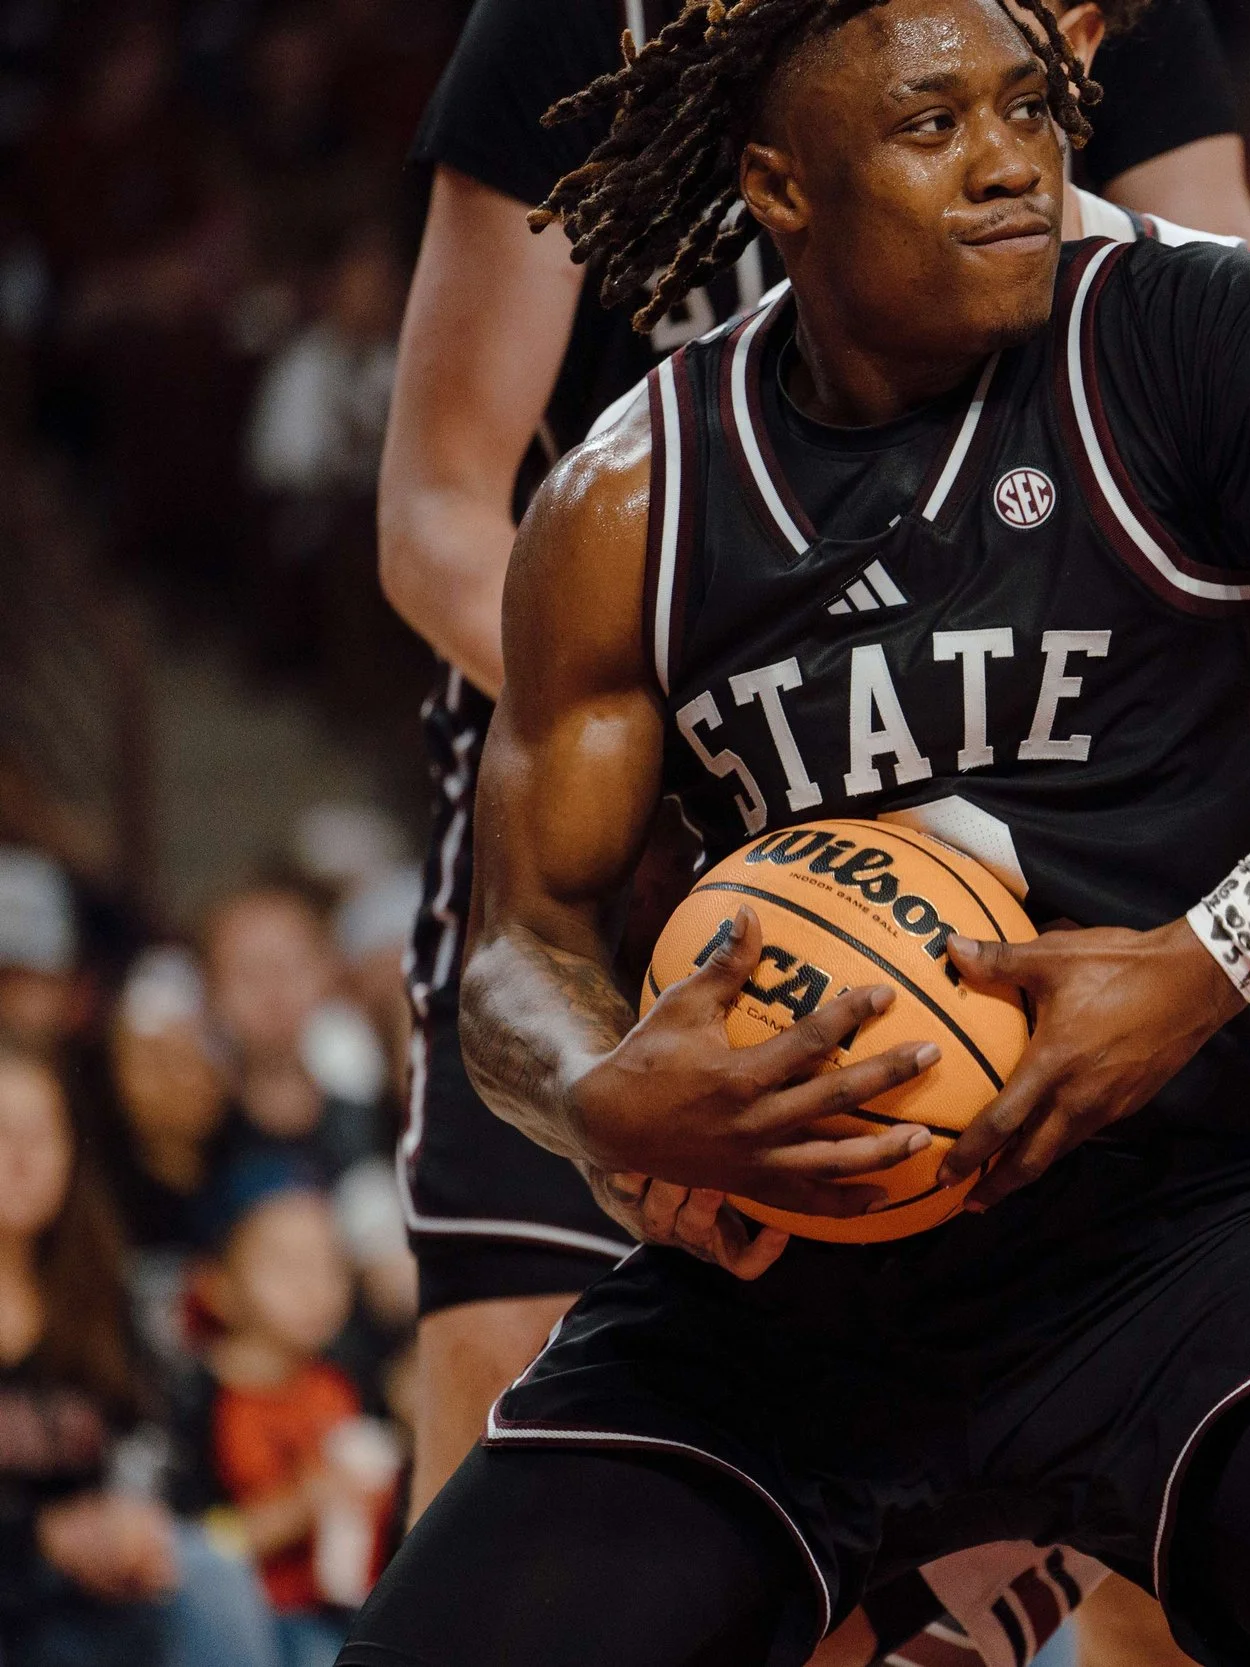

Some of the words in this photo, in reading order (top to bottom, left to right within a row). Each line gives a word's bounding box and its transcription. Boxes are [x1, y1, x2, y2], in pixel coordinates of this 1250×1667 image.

[998, 471, 1051, 525] SEC
[675, 627, 1112, 836] STATE
[789, 872, 834, 892] INDOOR
[836, 890, 870, 914] GAME
[872, 914, 899, 939] BALL
[693, 918, 862, 1052] CA
[746, 1007, 785, 1033] GAM
